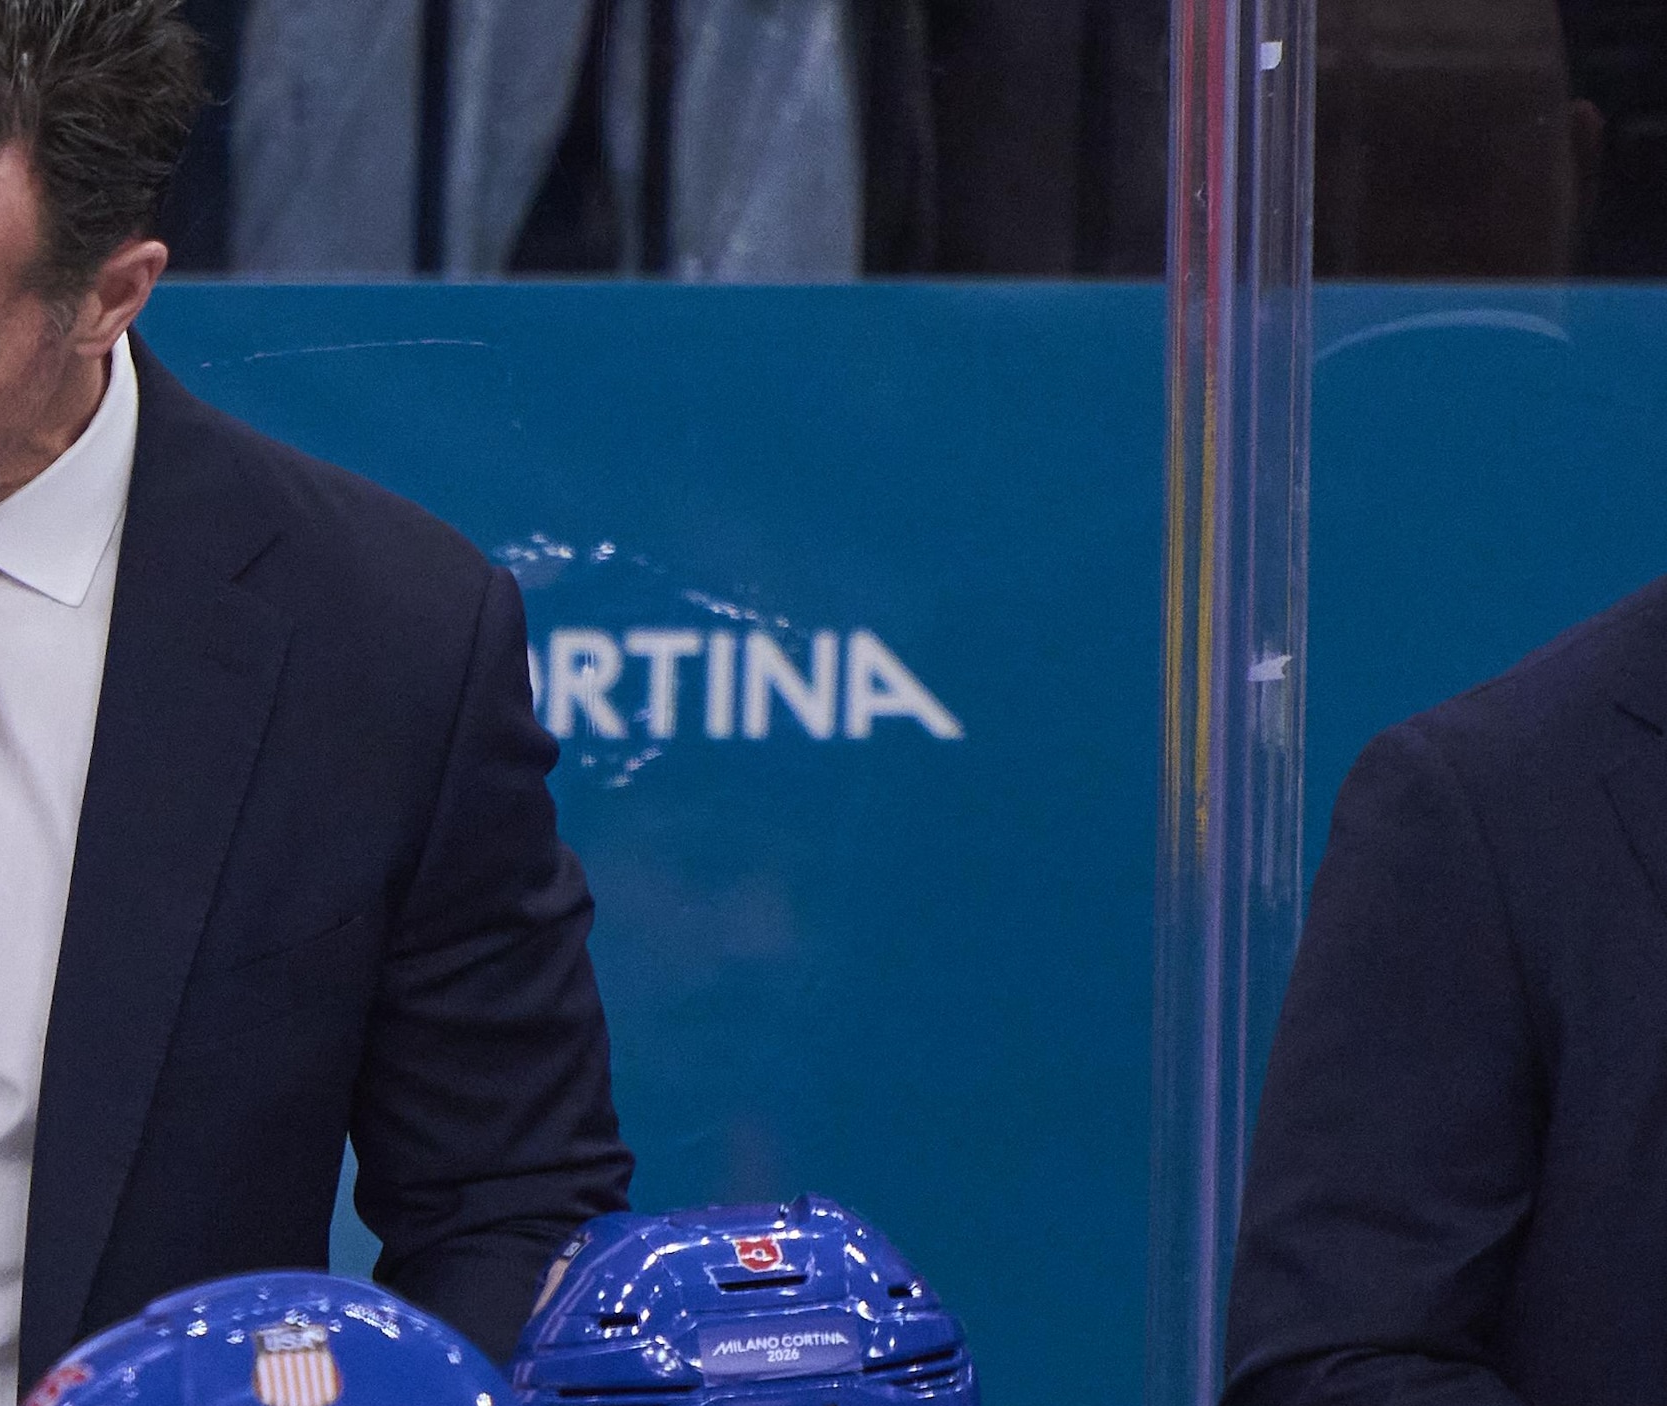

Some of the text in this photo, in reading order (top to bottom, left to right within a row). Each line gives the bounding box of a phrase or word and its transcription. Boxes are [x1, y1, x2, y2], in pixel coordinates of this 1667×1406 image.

[527, 627, 966, 741] RTINA
[712, 1331, 851, 1357] MILANO CORTINA
[766, 1347, 801, 1363] 2026
